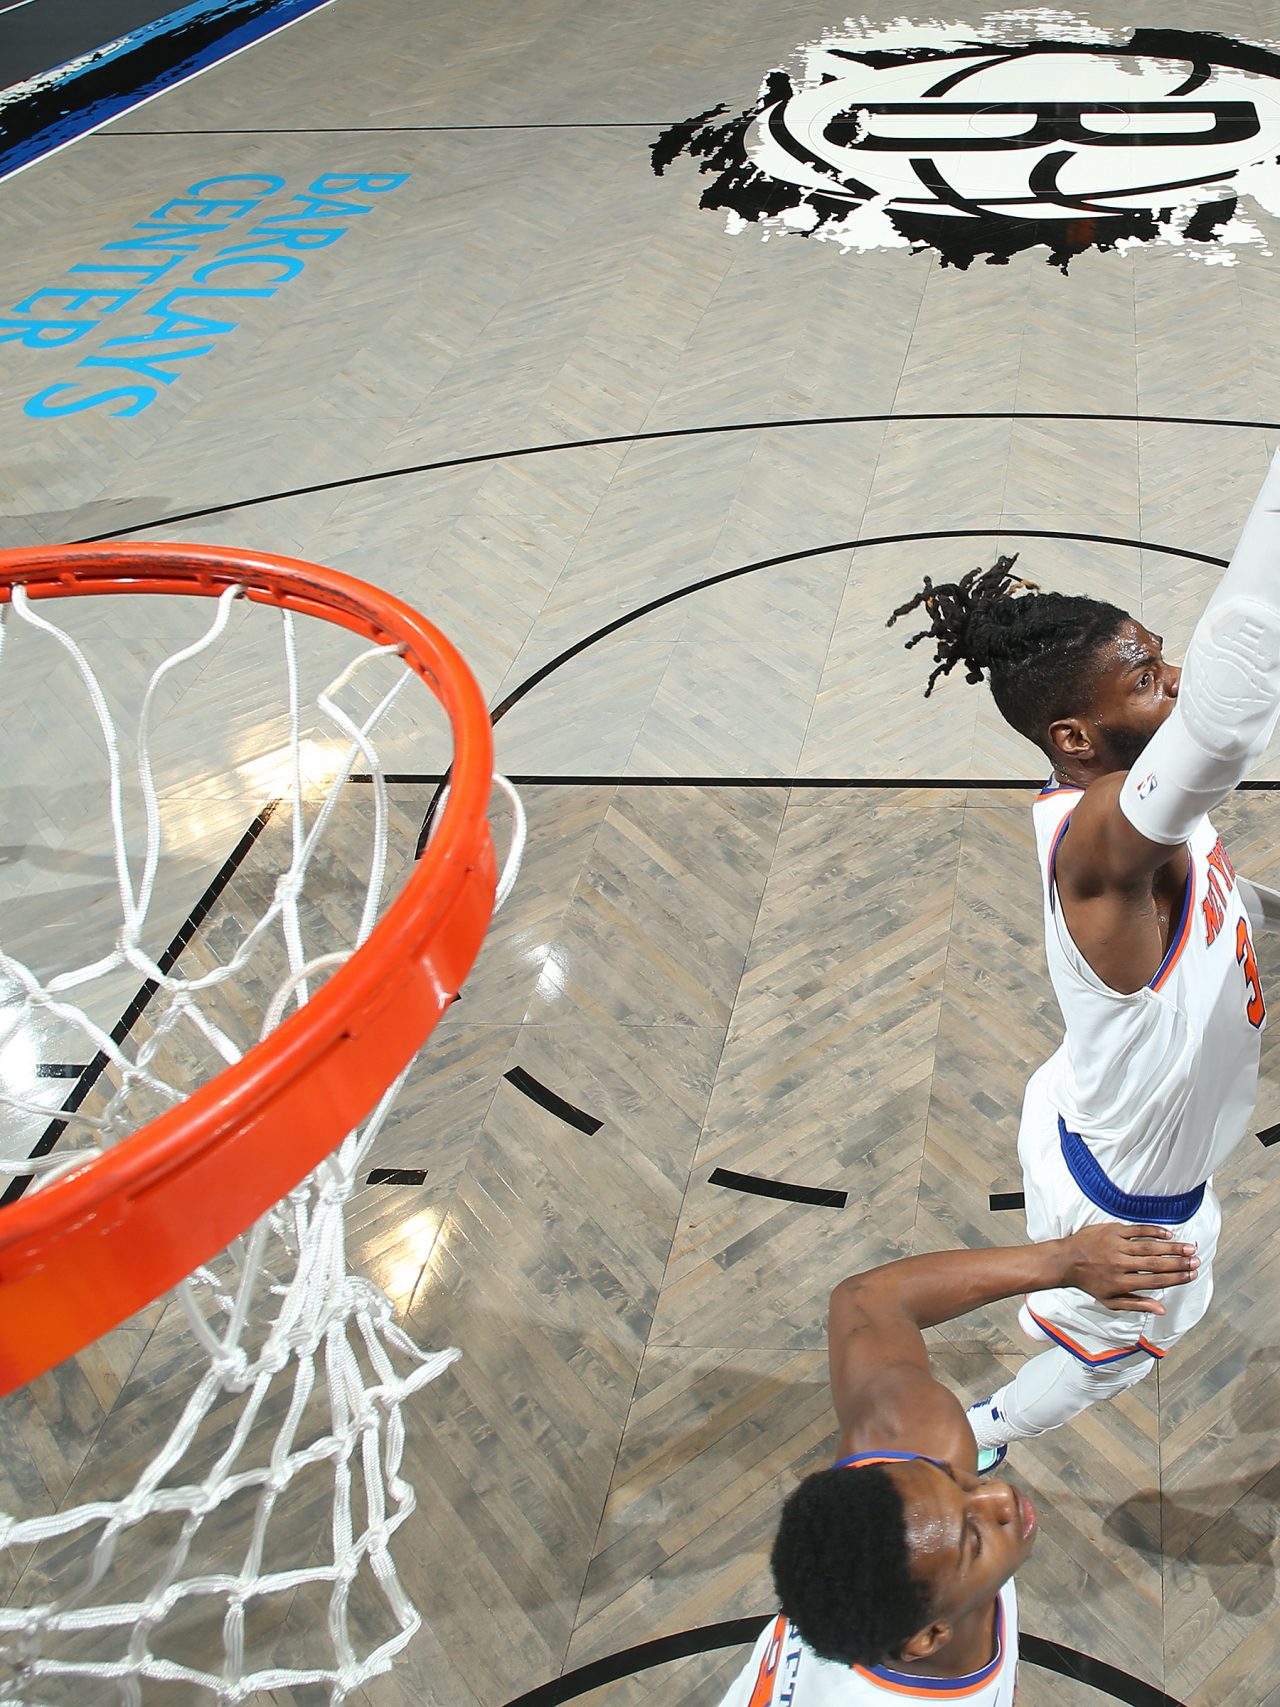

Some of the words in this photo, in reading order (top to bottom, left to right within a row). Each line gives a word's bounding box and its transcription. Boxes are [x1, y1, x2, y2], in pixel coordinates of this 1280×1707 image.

[0, 173, 286, 348] CENTER
[23, 173, 412, 418] BARCLAYS
[1236, 915, 1266, 1030] 3
